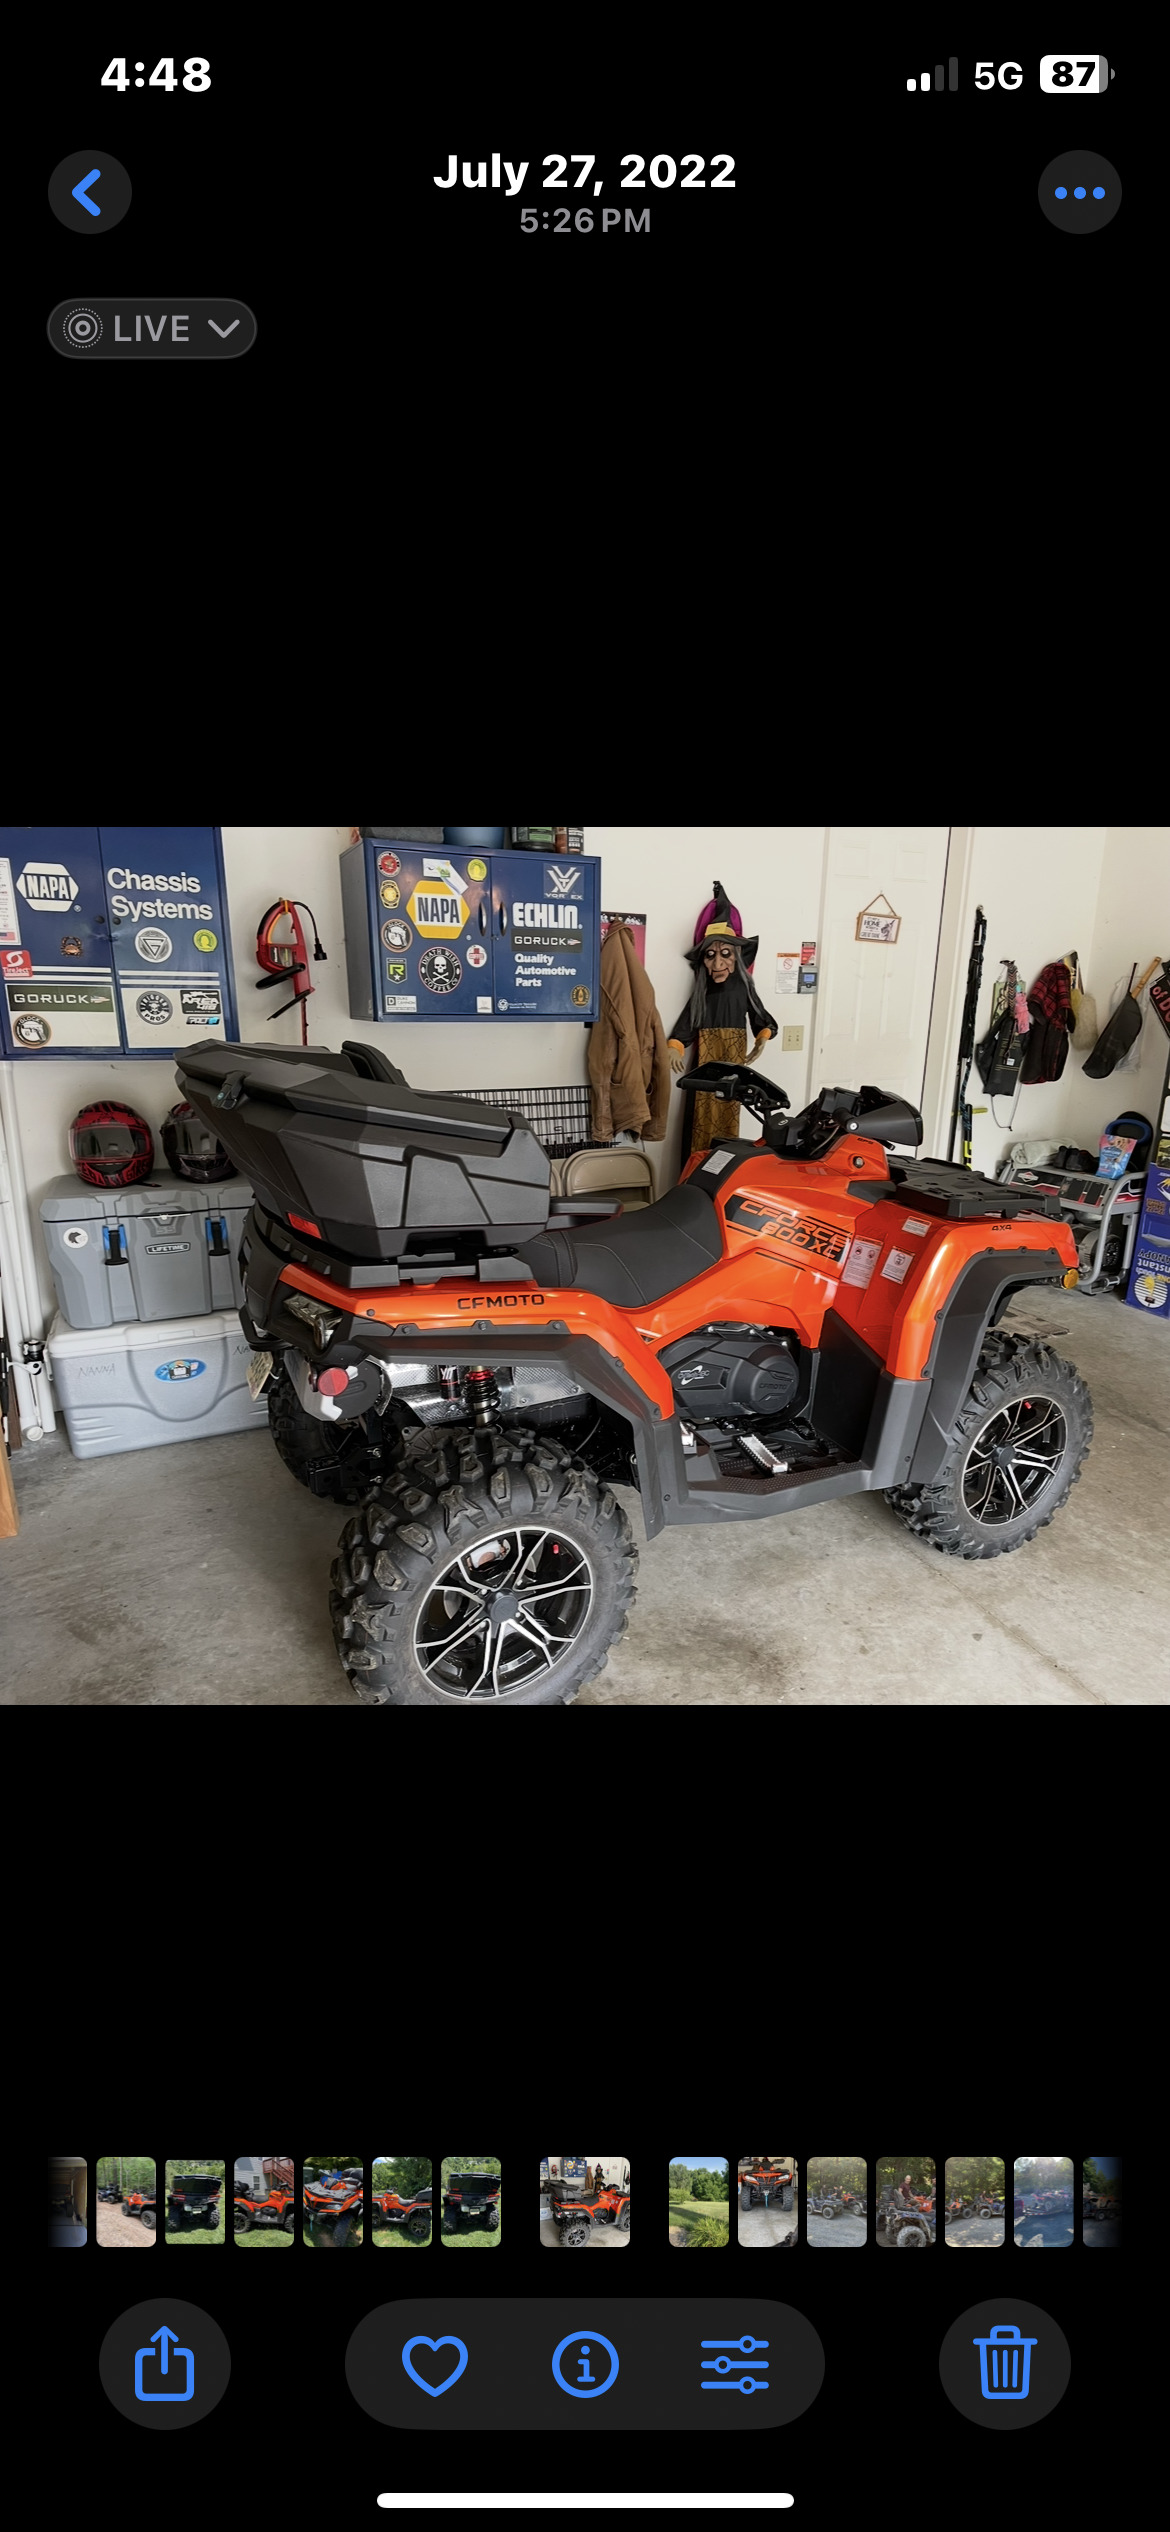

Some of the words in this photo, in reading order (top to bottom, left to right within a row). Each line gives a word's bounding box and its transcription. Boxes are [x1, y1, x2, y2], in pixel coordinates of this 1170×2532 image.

[25, 873, 70, 901] NAPA
[107, 867, 201, 893] Chassis
[111, 895, 213, 923] Systems
[417, 897, 460, 924] NAPA
[512, 902, 578, 929] ECHLIN
[514, 936, 567, 946] GORUCK
[422, 948, 442, 965] DEATH
[445, 949, 460, 967] WISH
[514, 953, 554, 966] Quality
[515, 966, 577, 976] Automotive
[515, 977, 543, 987] Parts
[14, 994, 89, 1004] GORUCK
[739, 1200, 850, 1248] CFORCE
[760, 1221, 811, 1247] 800
[151, 1244, 186, 1252] LIFETIME
[457, 1294, 545, 1310] CFMOTO
